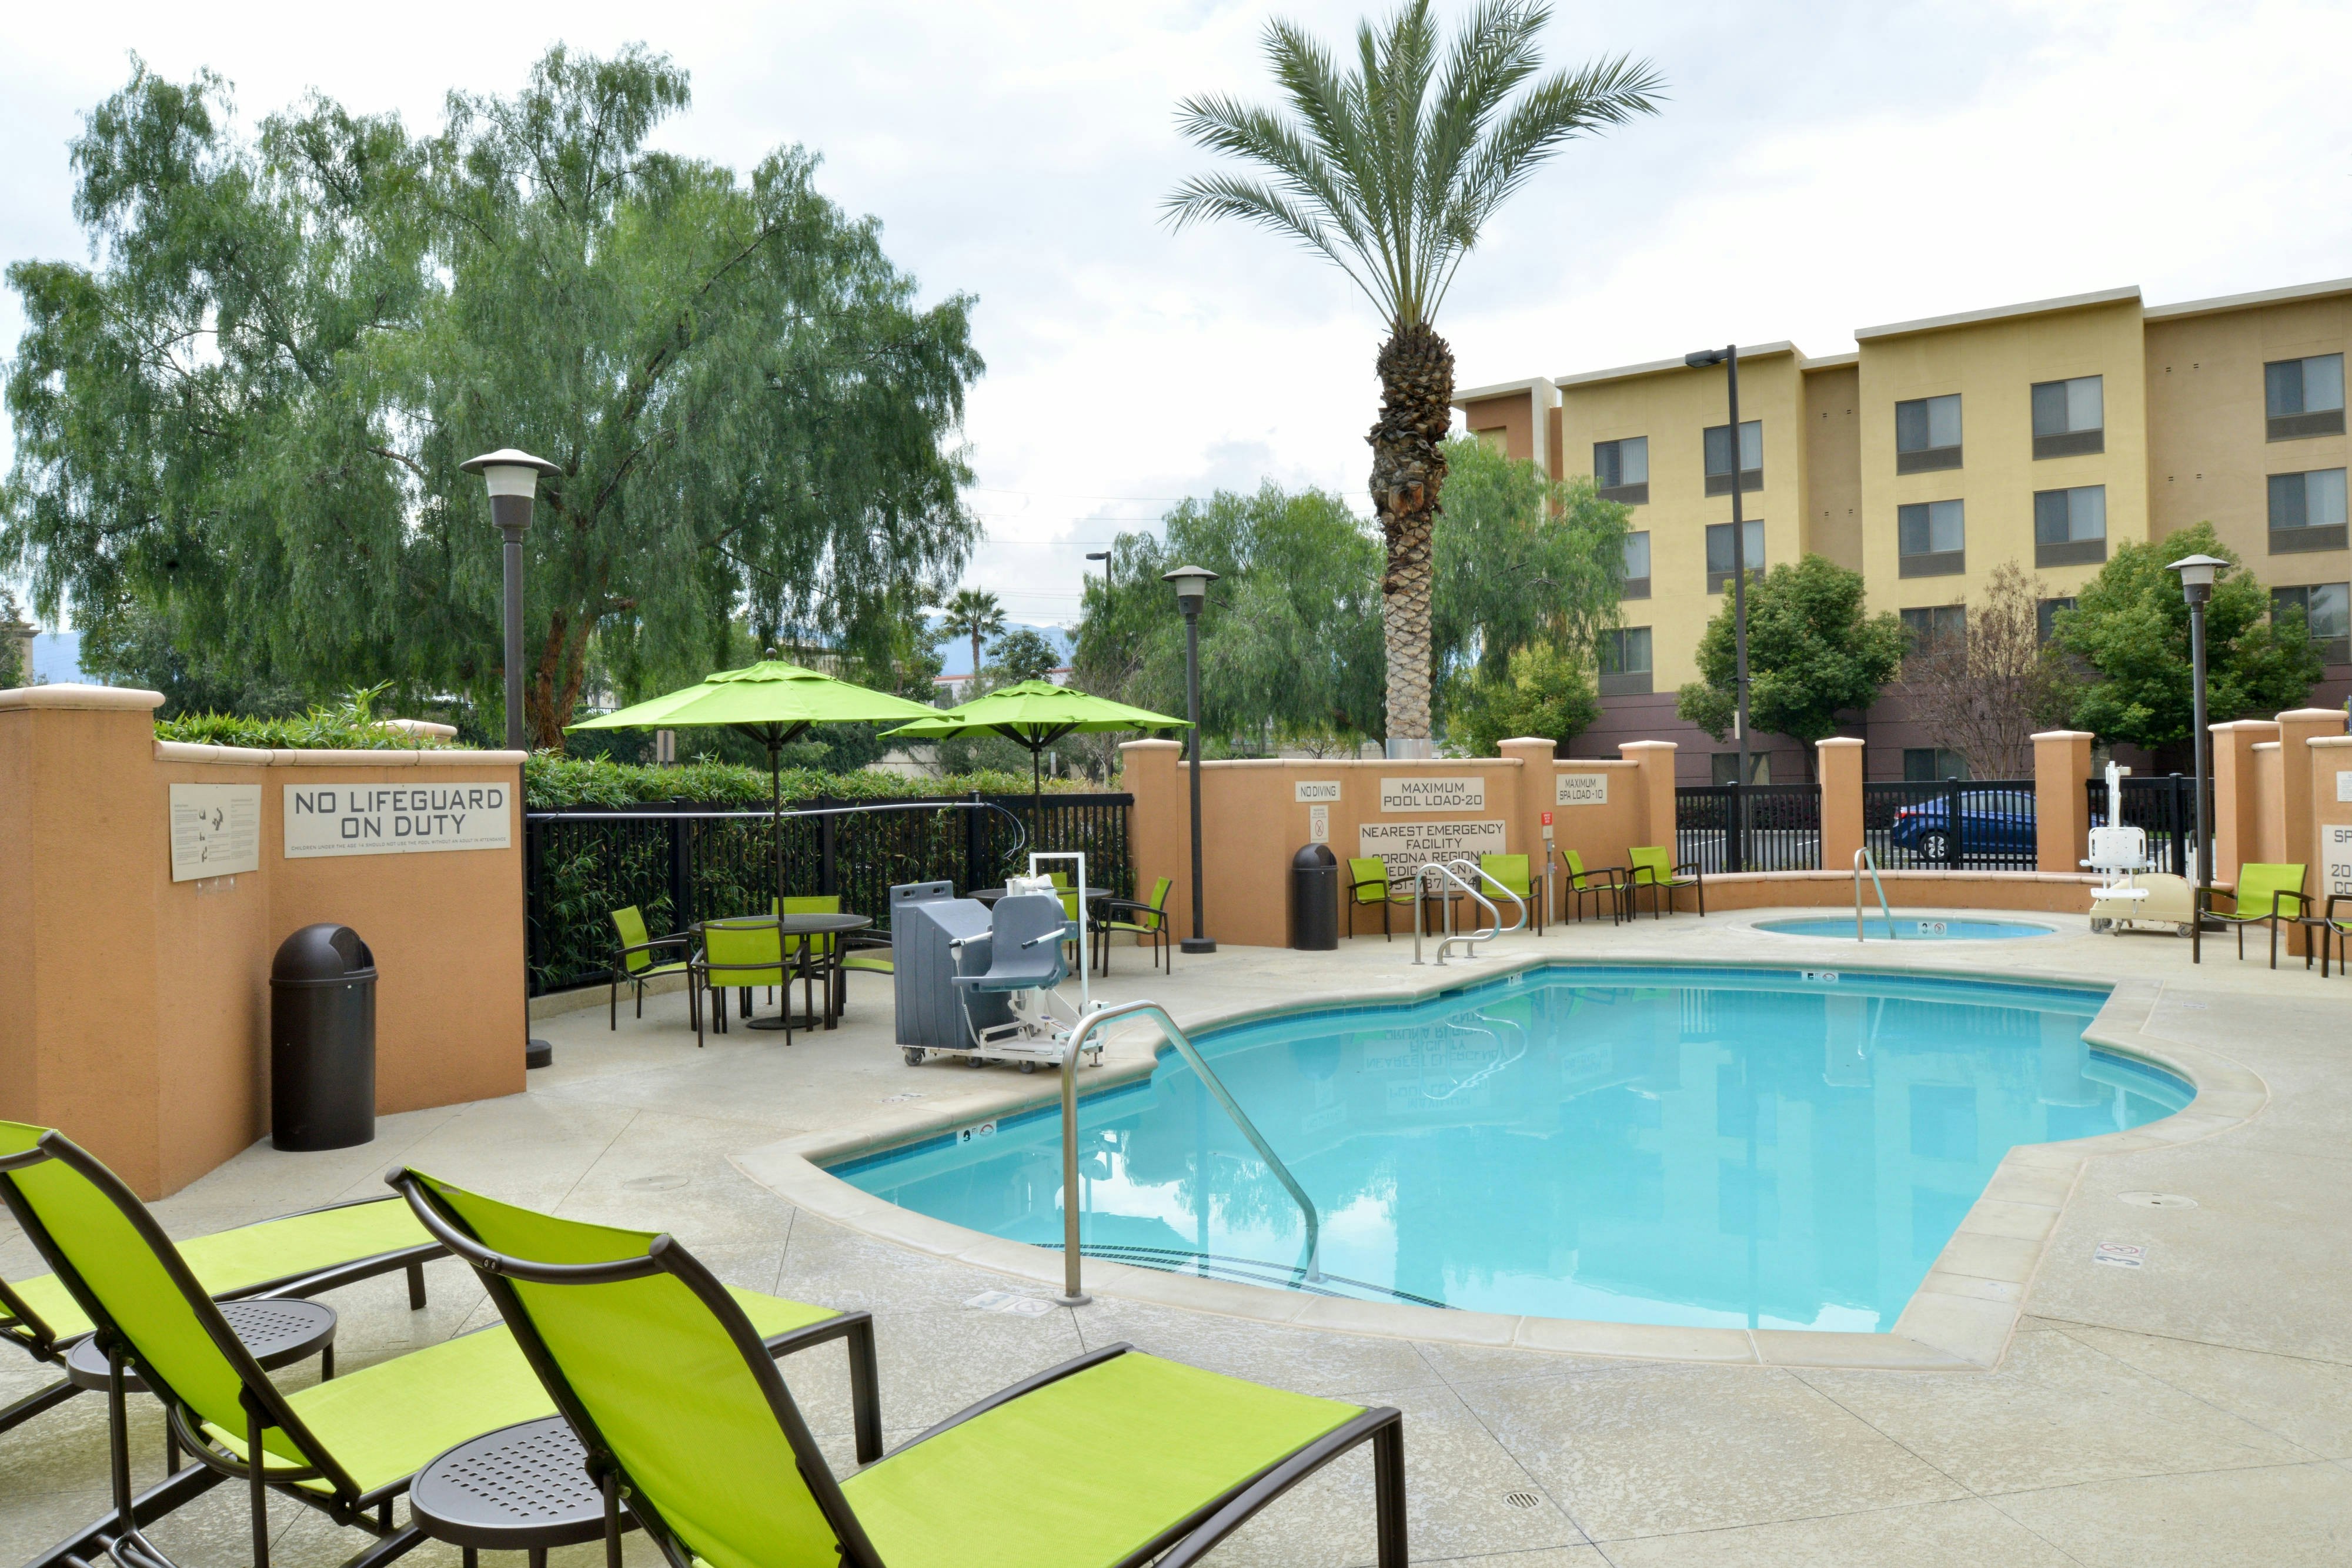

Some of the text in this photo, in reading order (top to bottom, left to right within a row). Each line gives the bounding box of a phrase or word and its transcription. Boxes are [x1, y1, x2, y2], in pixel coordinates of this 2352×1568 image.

[1402, 783, 1464, 794] MAXIMUM
[1565, 778, 1596, 788] MAXIMUM
[1301, 785, 1336, 797] NO DIVING
[1559, 790, 1571, 800] SPA
[296, 789, 503, 814] NO LIFEGUARD
[1384, 795, 1482, 807] POOL LOAD-20
[342, 814, 466, 838] ON DUTY
[1362, 824, 1503, 838] NEAREST EMERGENCY
[1406, 838, 1462, 850] FACILITY
[1432, 850, 1492, 862] REGION
